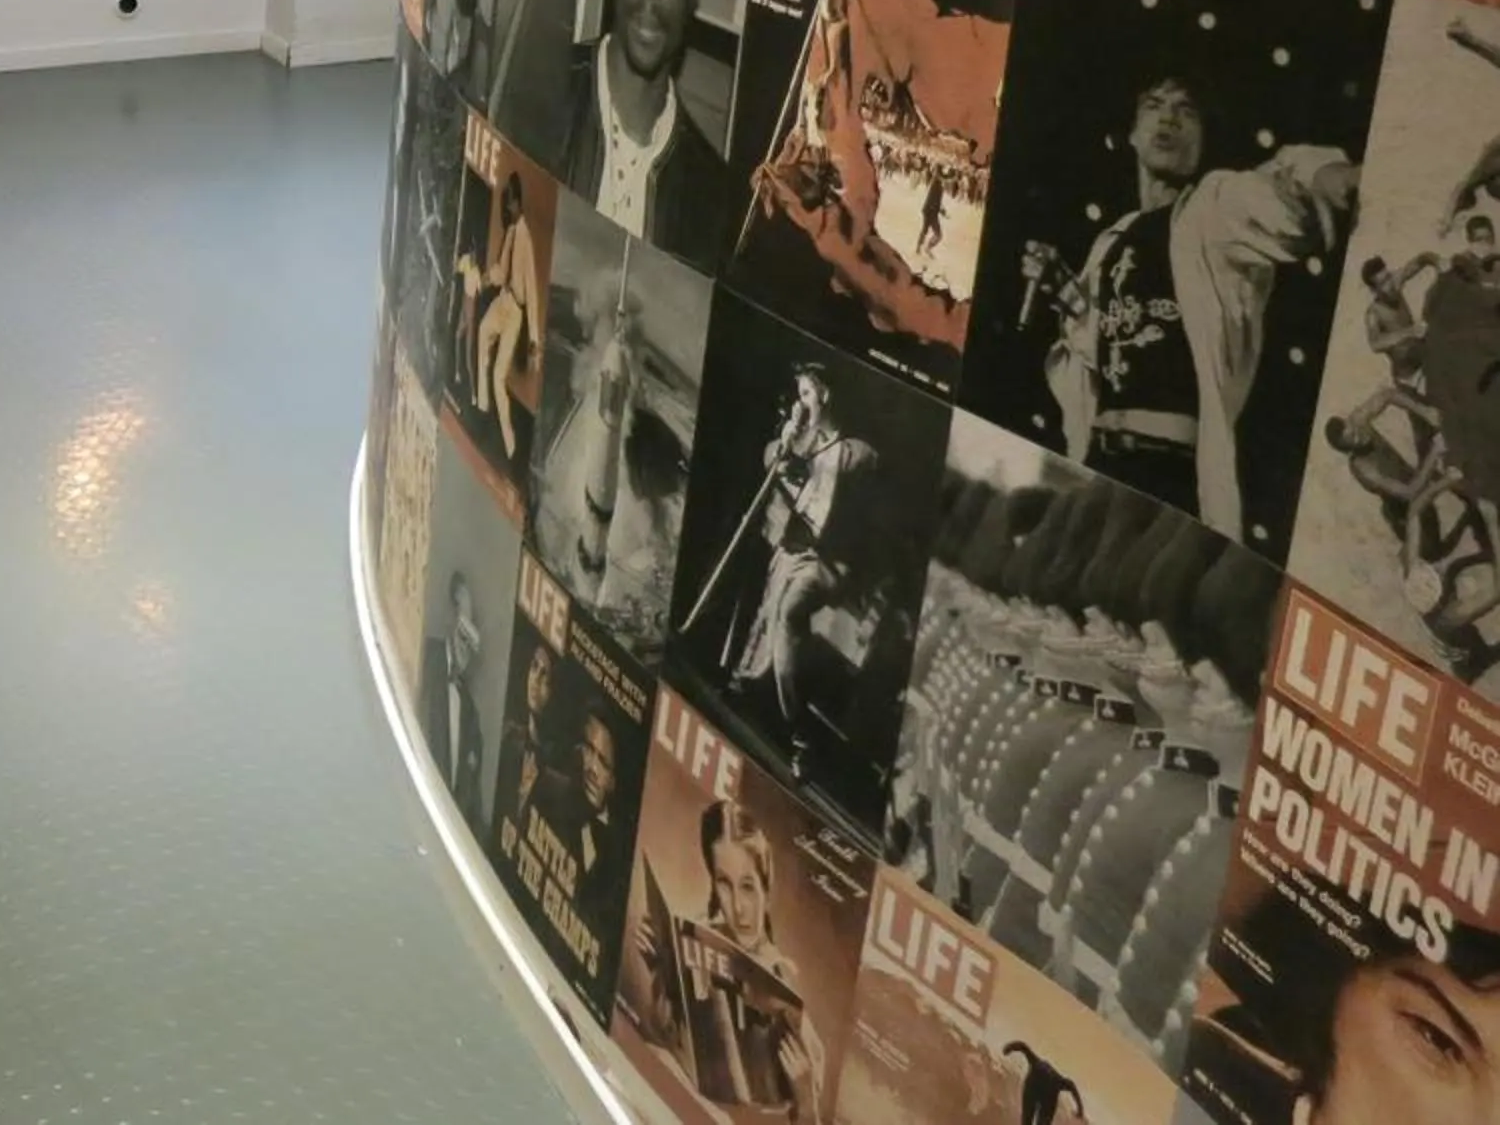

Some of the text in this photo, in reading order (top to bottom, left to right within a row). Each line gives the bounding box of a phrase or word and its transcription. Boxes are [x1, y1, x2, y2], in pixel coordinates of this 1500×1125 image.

[465, 114, 501, 186] LIFE
[518, 553, 571, 658] LIFE
[1285, 608, 1430, 766] LIFE
[655, 690, 741, 801] LIFE
[527, 804, 578, 900] BATTLE
[1262, 696, 1500, 917] WOMEN IN
[518, 838, 543, 901] THE
[542, 876, 600, 978] CHAMPS
[1248, 765, 1454, 964] POLITICS
[1291, 867, 1317, 896] they
[1319, 891, 1362, 929] doing?
[681, 936, 735, 984] LIFE
[877, 887, 993, 1018] LIFE
[1298, 895, 1326, 927] they
[1327, 921, 1371, 961] going?
